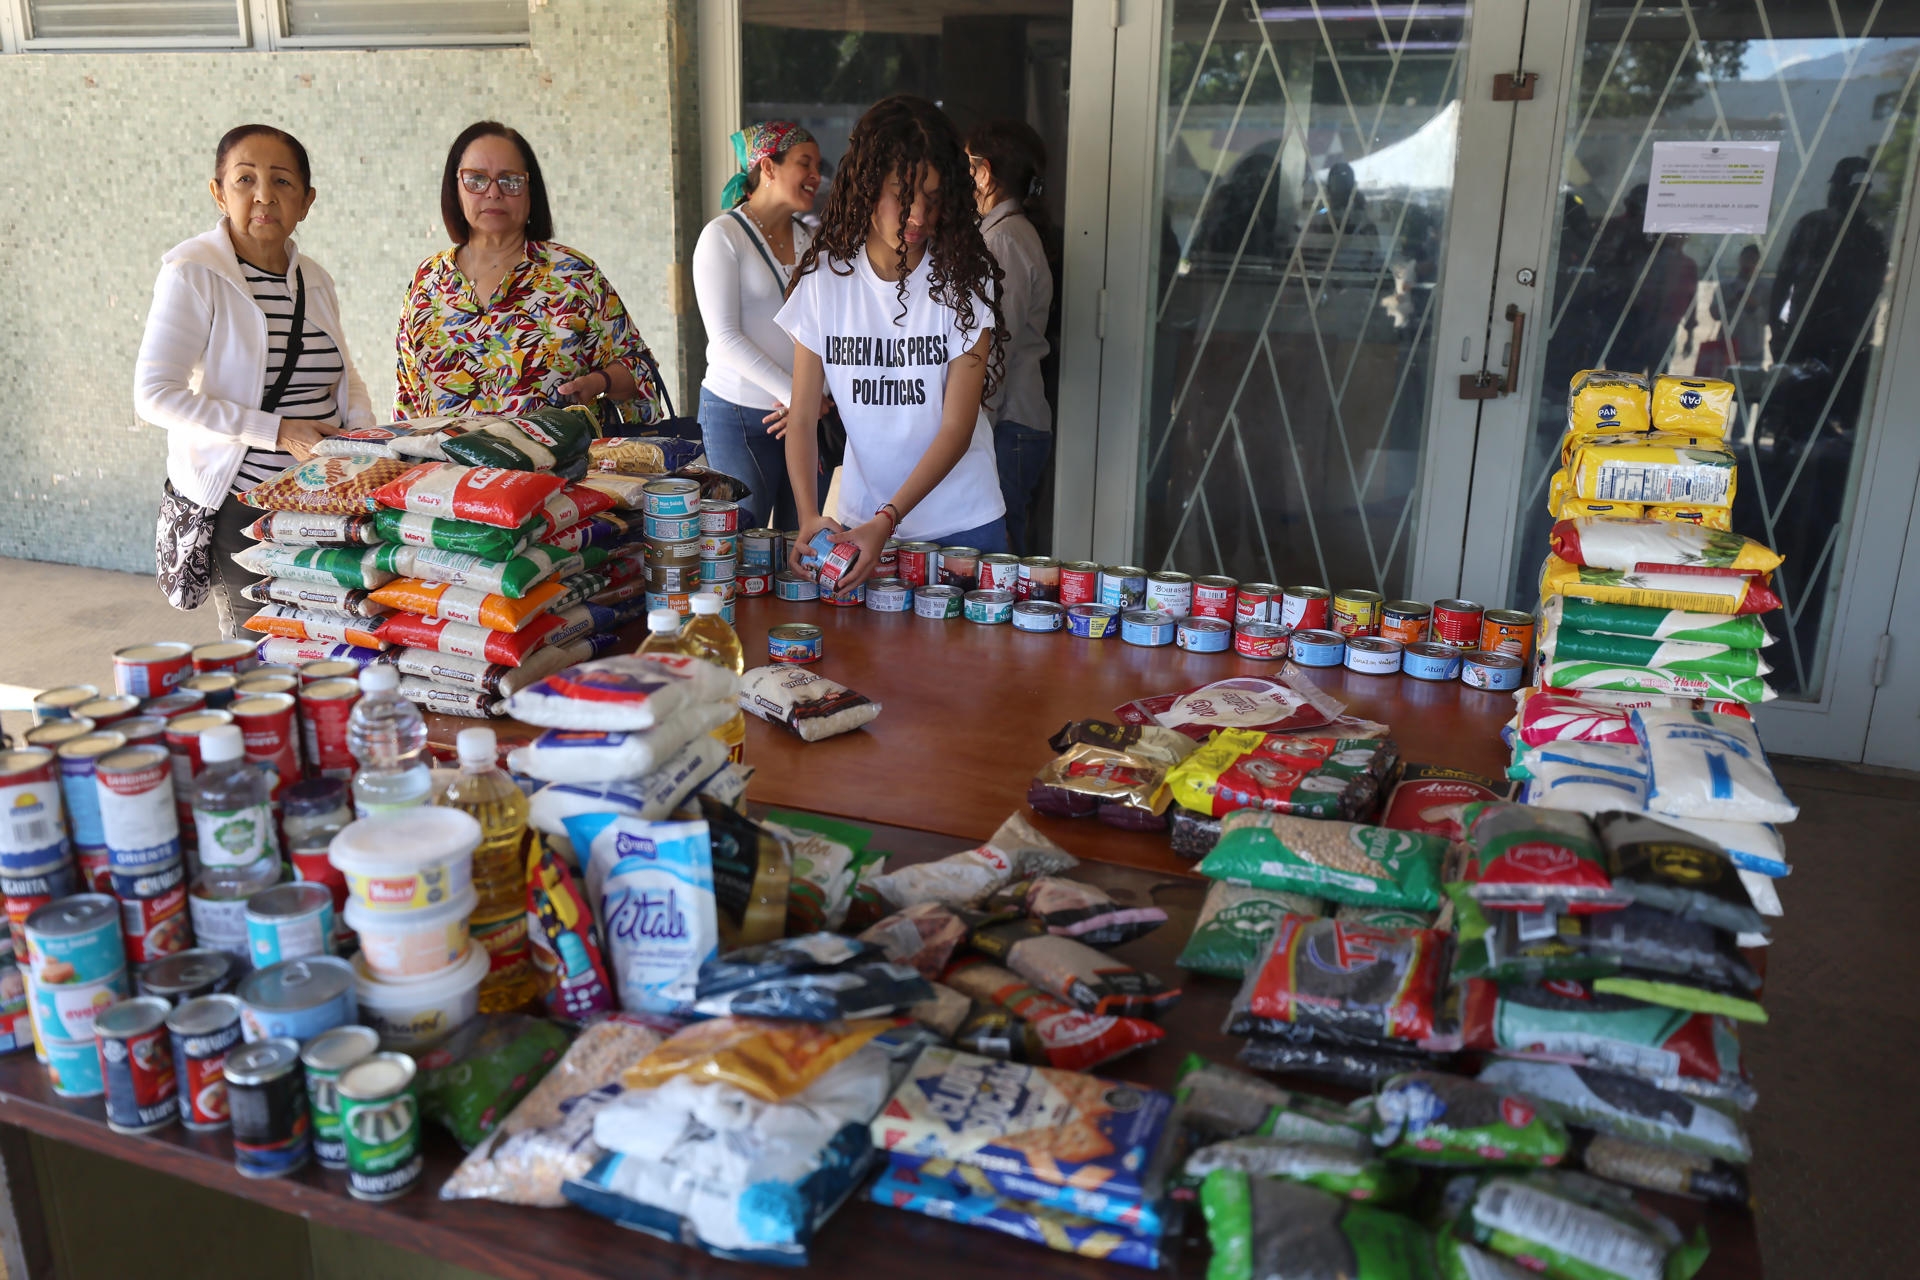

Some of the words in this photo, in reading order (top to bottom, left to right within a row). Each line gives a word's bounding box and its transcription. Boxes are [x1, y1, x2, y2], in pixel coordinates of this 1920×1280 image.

[874, 338, 884, 366] A
[886, 338, 906, 368] LAS
[853, 376, 926, 405] POLÍTICAS
[1679, 395, 1703, 405] PAN
[1598, 408, 1618, 417] PAN
[514, 418, 552, 444] Mary
[417, 495, 442, 506] Mary
[404, 532, 426, 544] Mary
[447, 610, 470, 622] Mary
[450, 646, 474, 658] Mary
[1424, 664, 1445, 673] Atún
[1673, 675, 1710, 689] Harina
[1416, 782, 1480, 797] Avena
